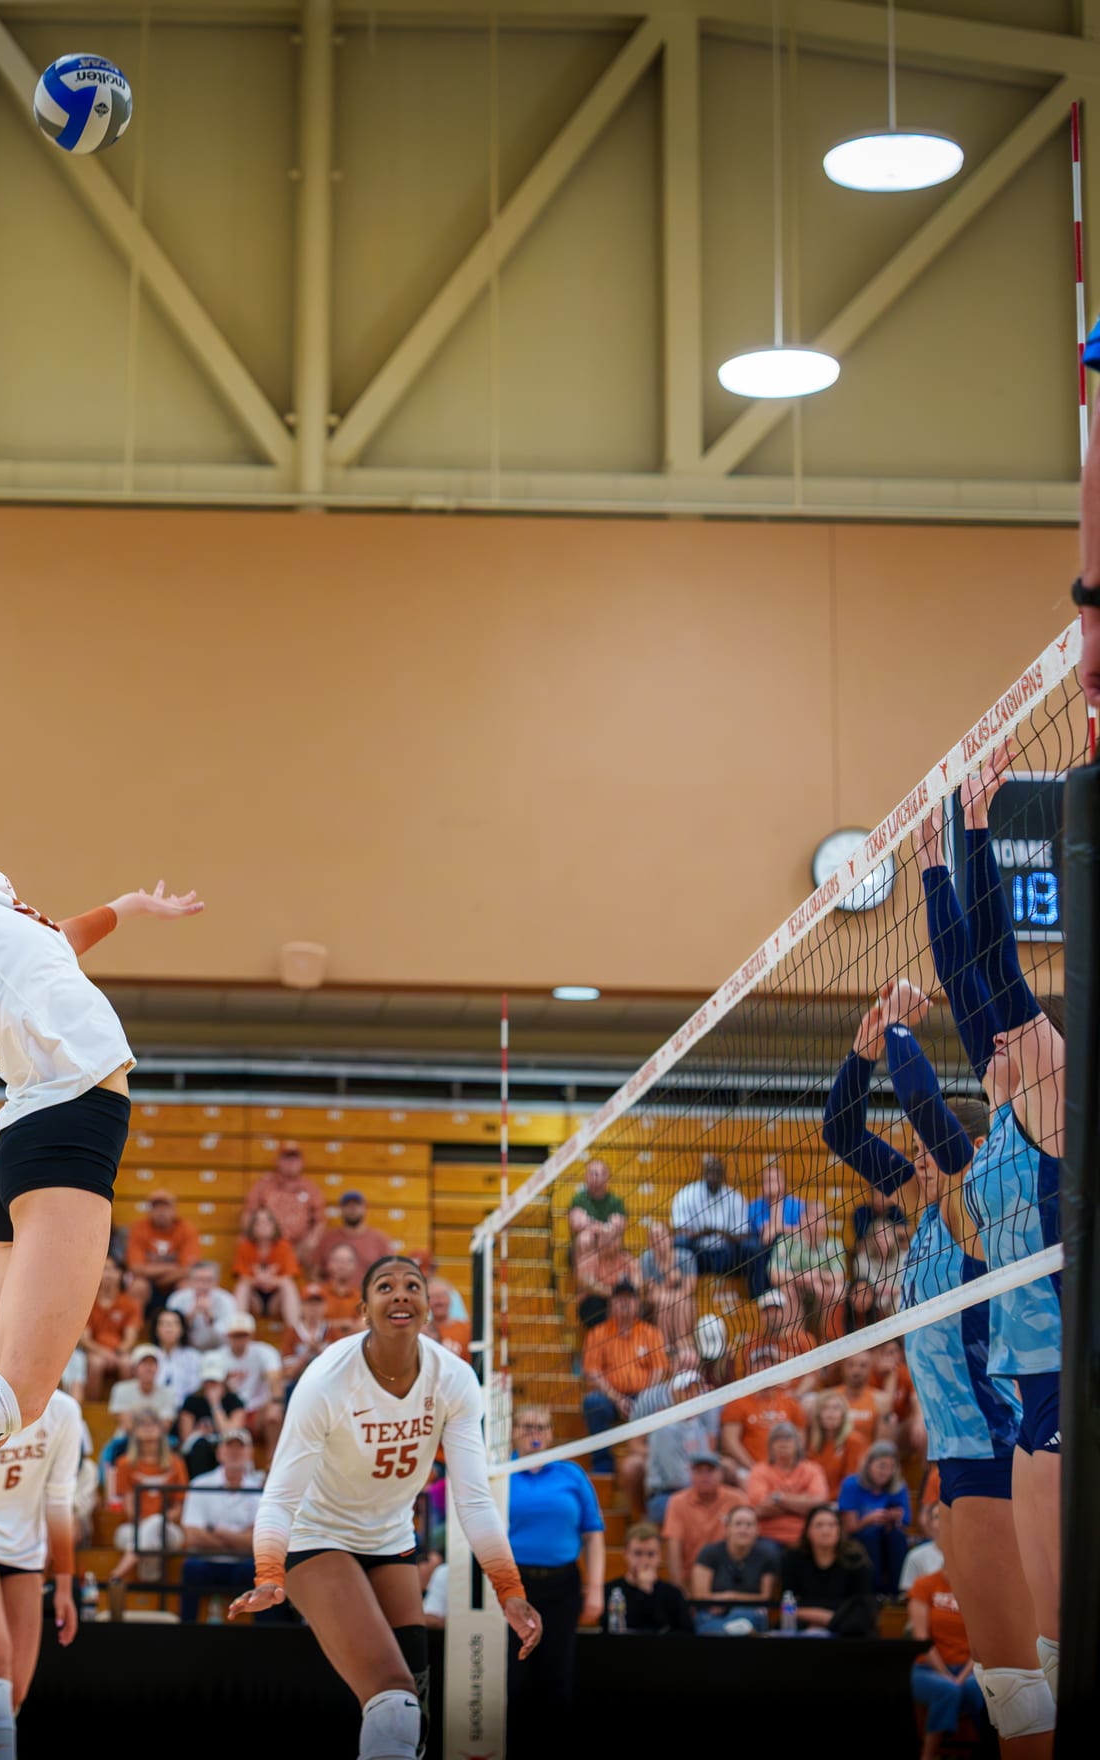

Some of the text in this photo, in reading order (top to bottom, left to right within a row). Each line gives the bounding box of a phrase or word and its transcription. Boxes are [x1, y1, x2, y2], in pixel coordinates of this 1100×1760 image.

[76, 71, 126, 89] molten
[1012, 872, 1058, 925] 18
[361, 1415, 434, 1443] TEXAS
[371, 1442, 419, 1479] 55
[3, 1464, 22, 1490] 6
